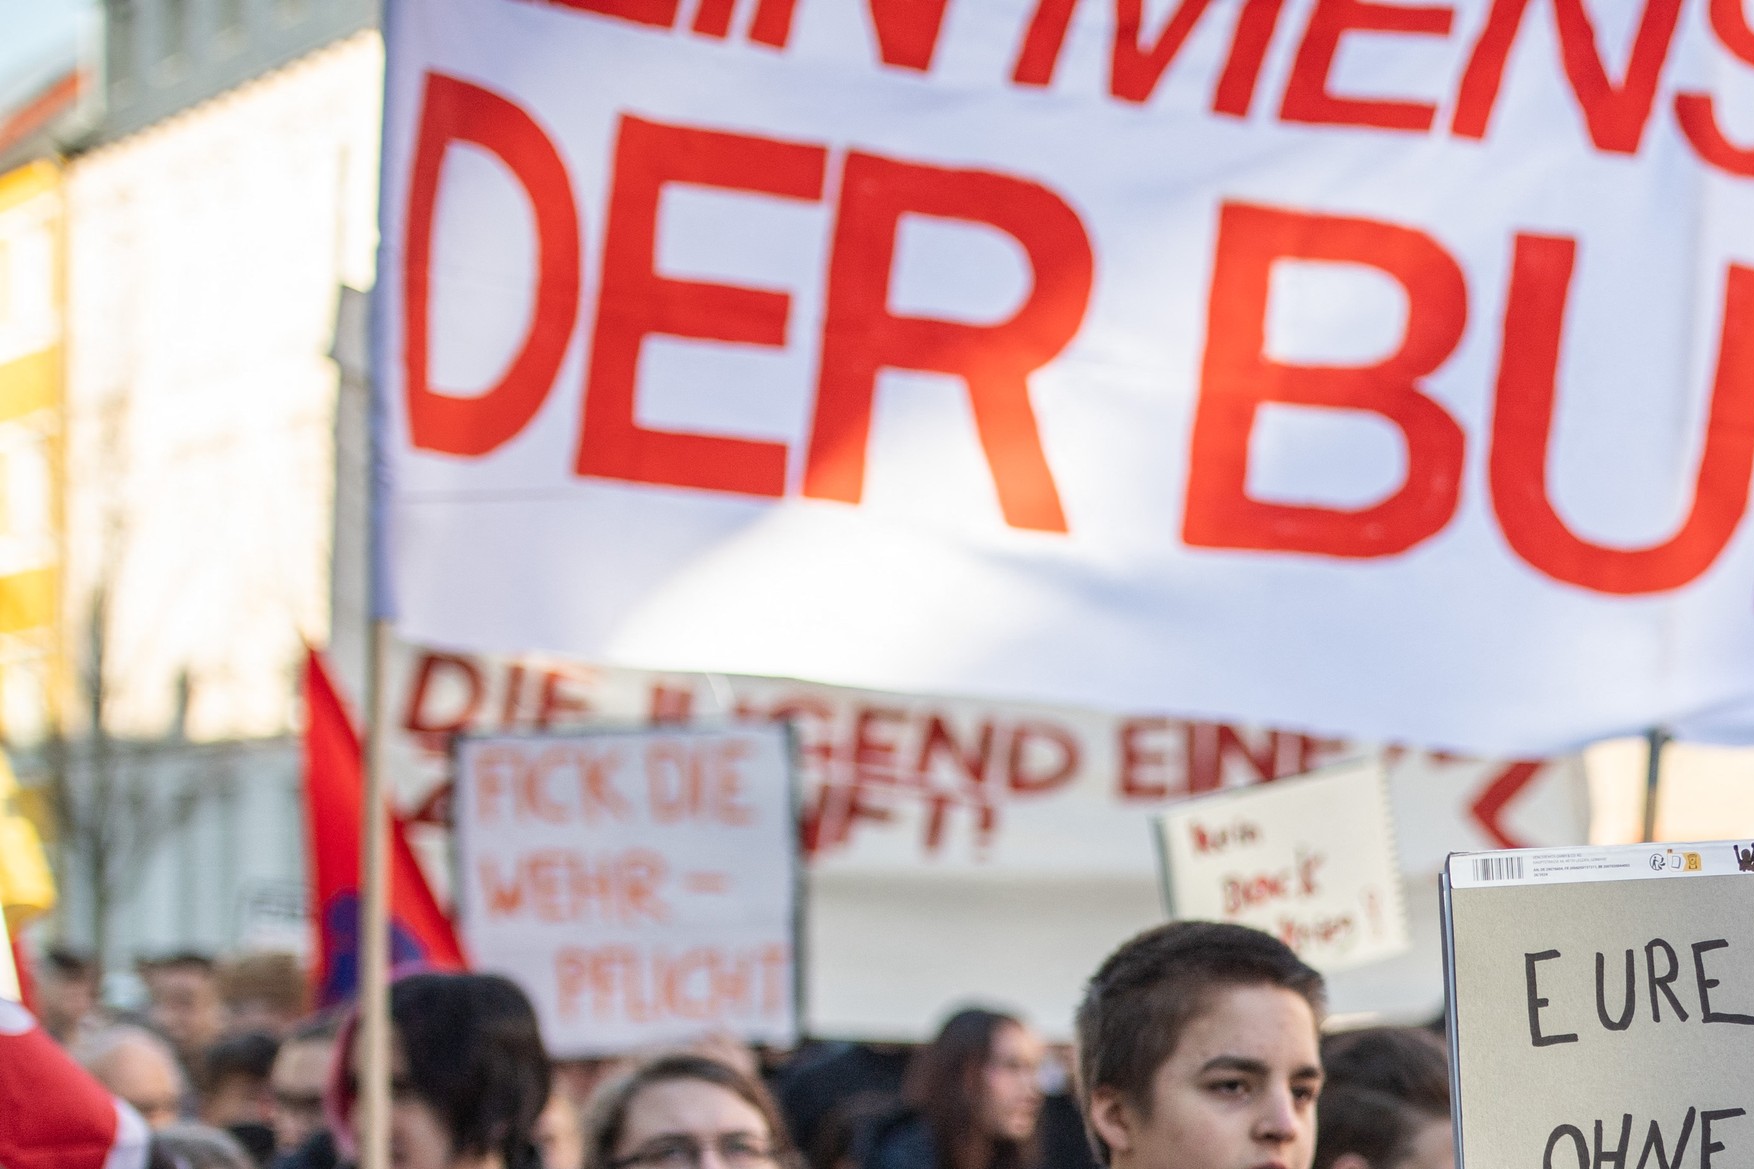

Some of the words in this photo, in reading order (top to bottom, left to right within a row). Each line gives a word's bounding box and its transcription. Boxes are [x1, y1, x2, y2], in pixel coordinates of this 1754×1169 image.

[402, 71, 1096, 533] DER
[645, 739, 761, 827] DIE
[554, 943, 790, 1023] PFLICHT
